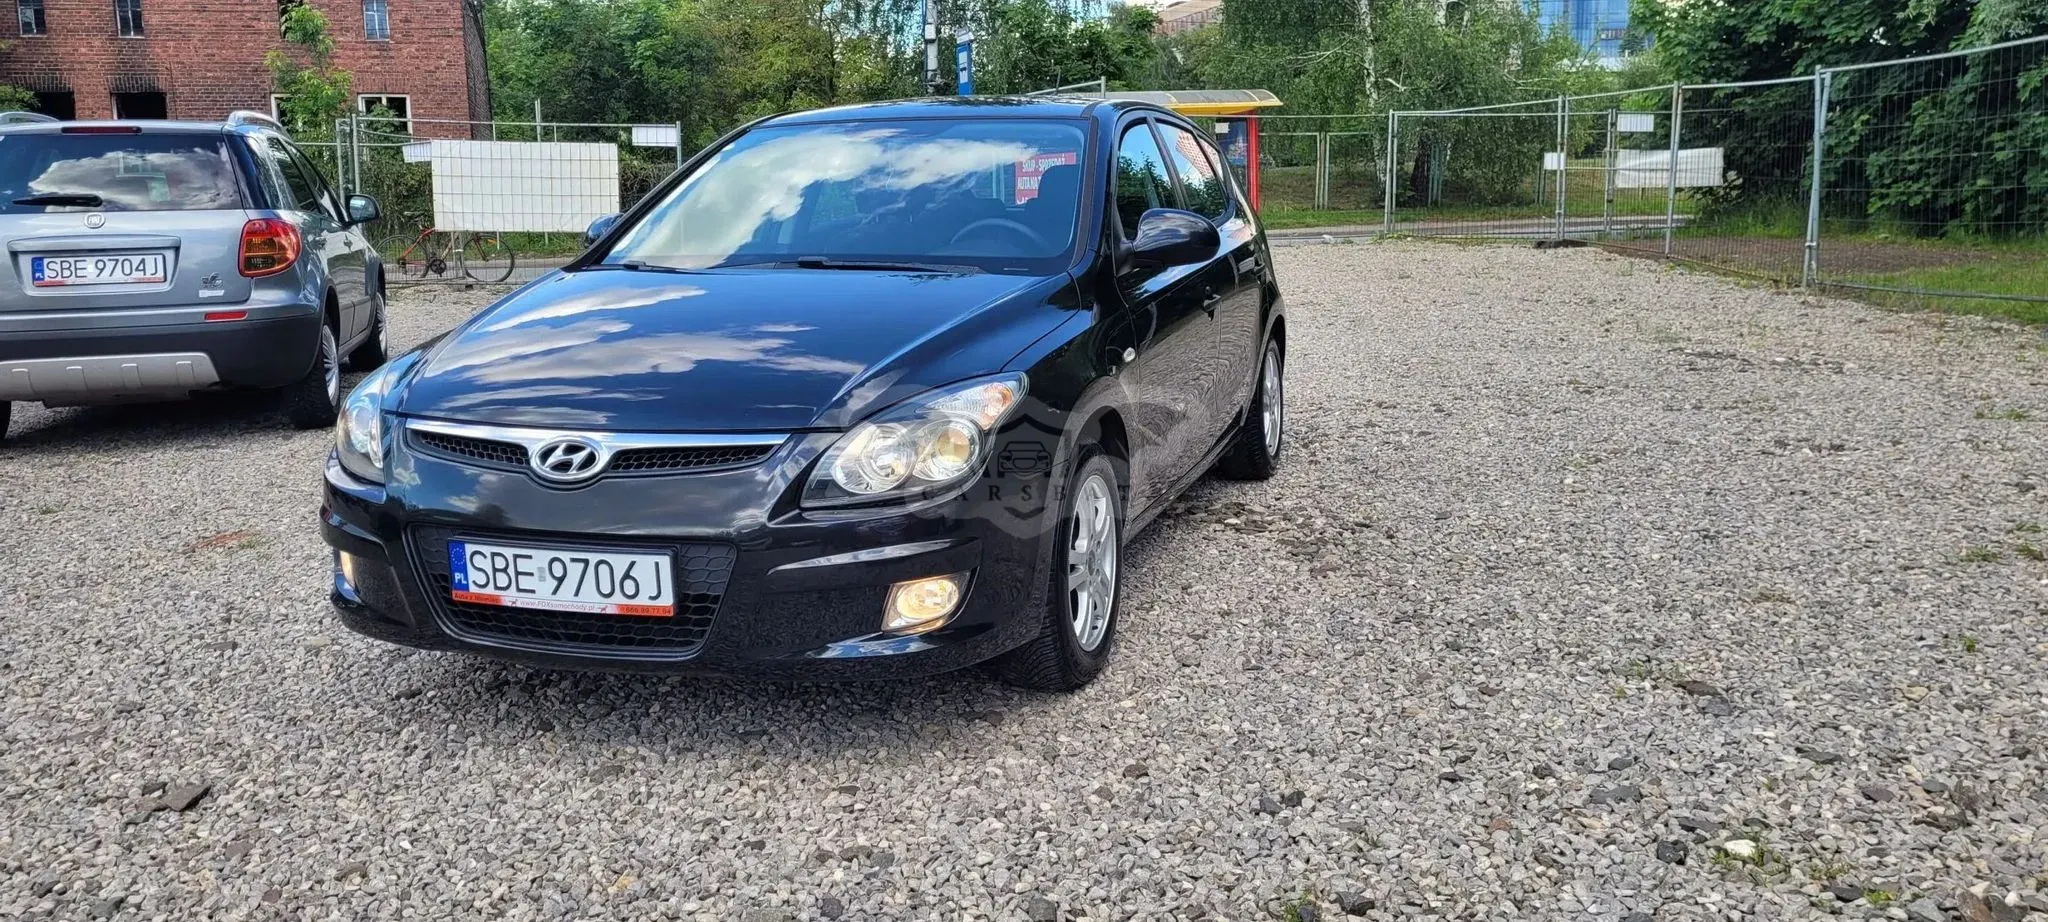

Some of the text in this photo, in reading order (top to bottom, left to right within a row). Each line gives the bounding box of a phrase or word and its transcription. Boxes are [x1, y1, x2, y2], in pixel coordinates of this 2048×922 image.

[46, 257, 158, 279] SBE 9704J
[454, 572, 468, 585] PL
[469, 549, 662, 601] SBE 9706J
